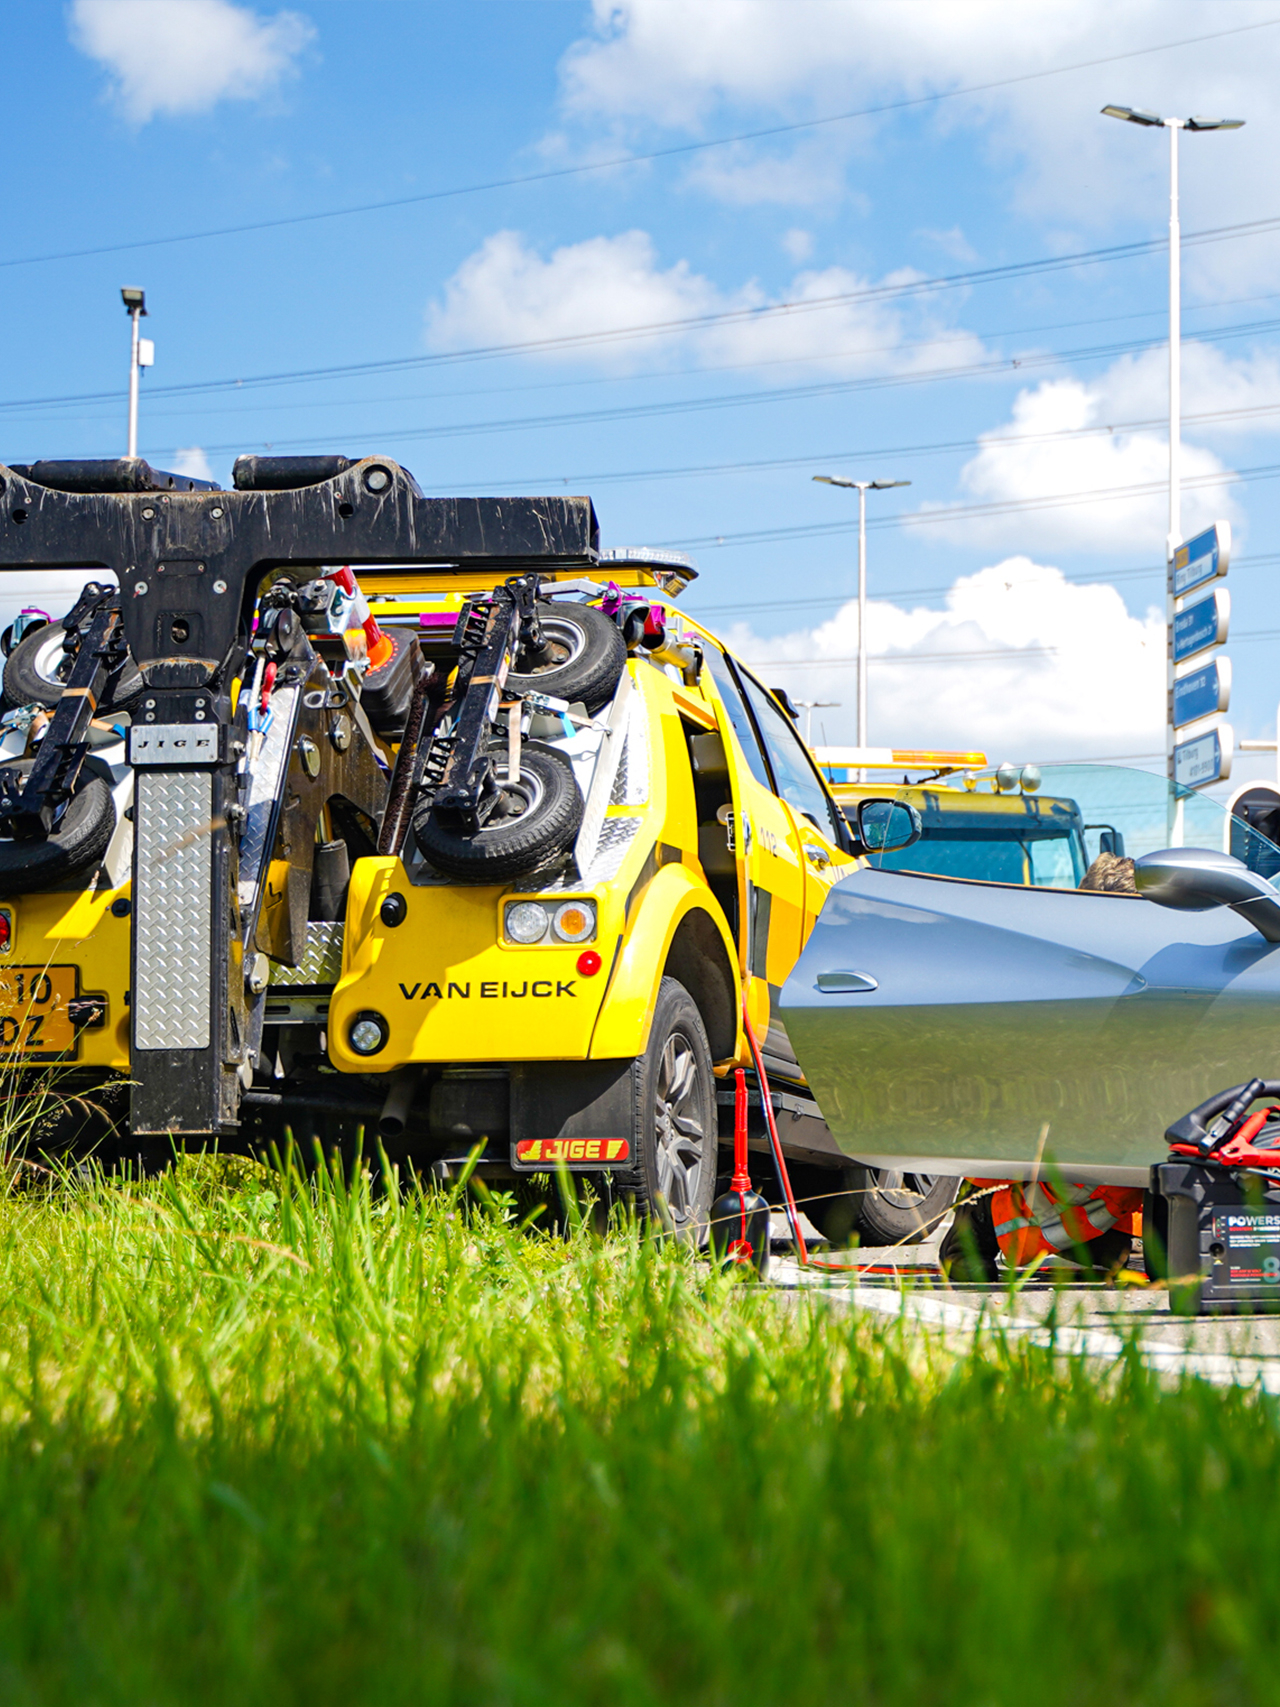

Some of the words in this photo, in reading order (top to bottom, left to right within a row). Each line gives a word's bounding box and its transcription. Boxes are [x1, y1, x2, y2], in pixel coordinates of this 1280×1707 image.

[138, 739, 210, 749] JIGE
[398, 982, 471, 1000] VAN
[480, 980, 577, 998] EIJCK
[545, 1140, 601, 1159] JIGE
